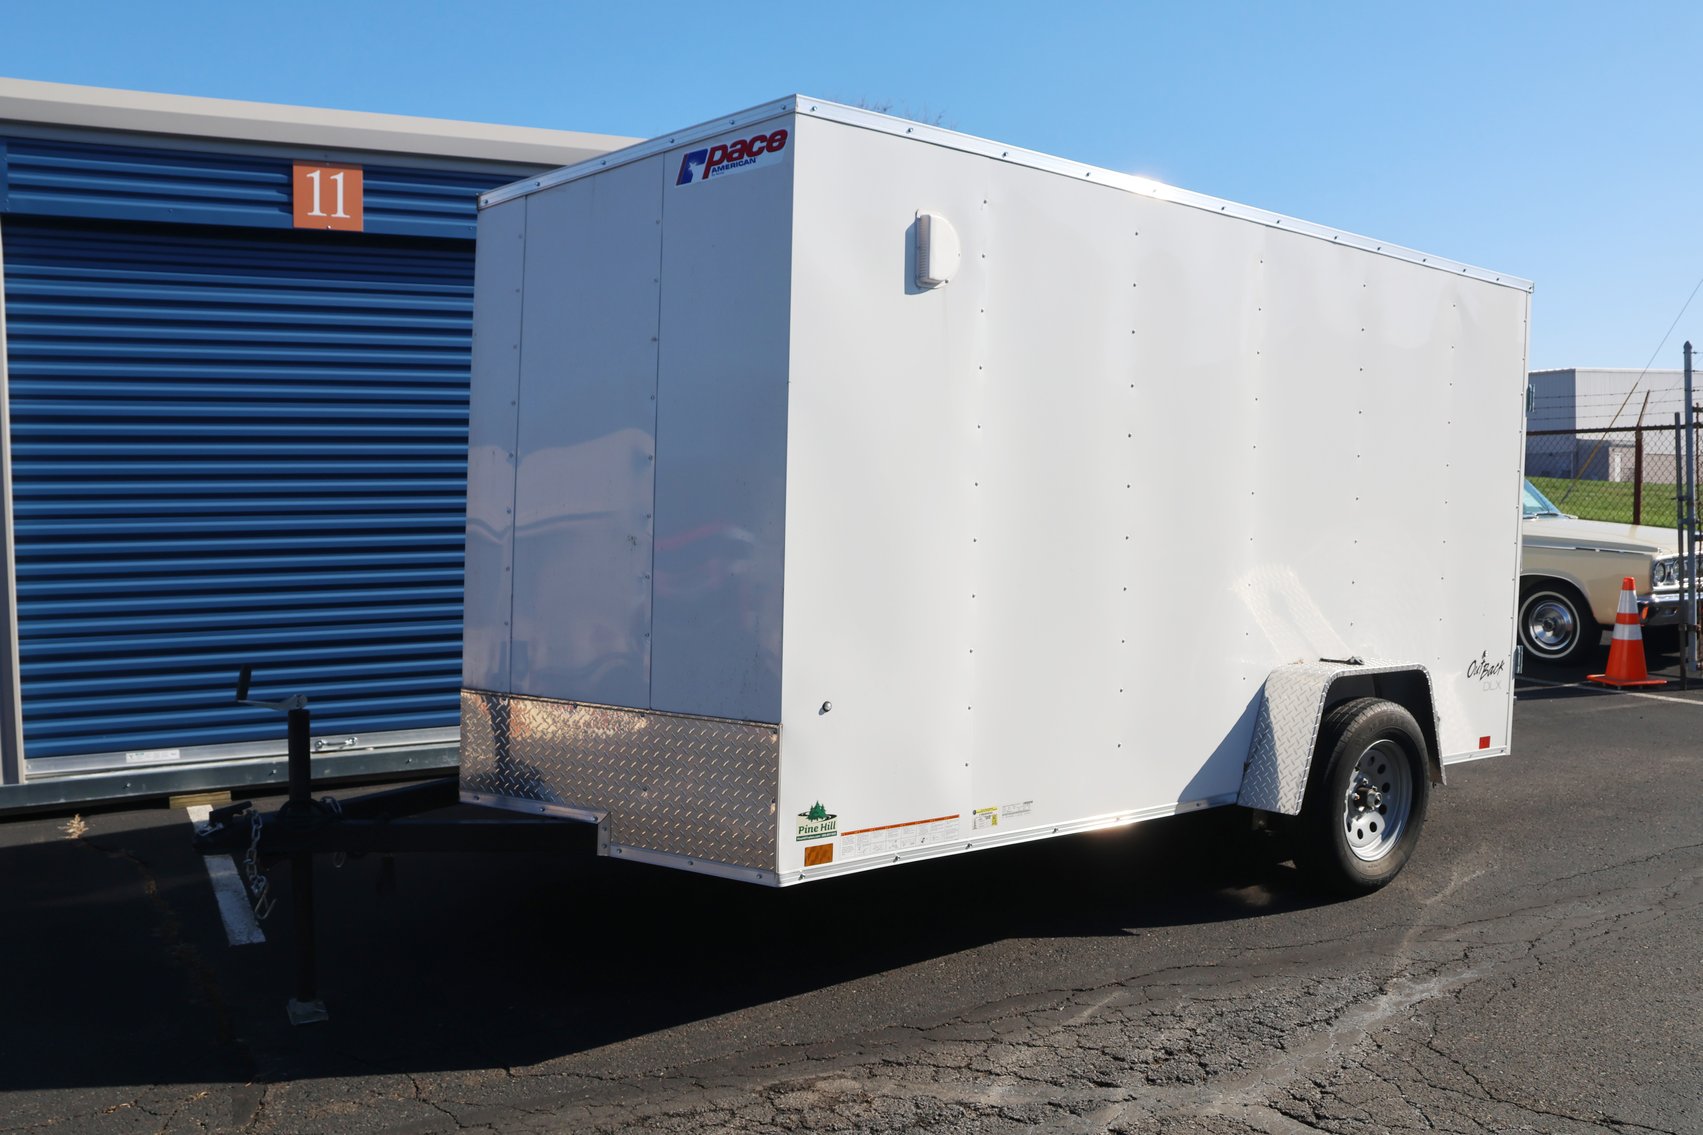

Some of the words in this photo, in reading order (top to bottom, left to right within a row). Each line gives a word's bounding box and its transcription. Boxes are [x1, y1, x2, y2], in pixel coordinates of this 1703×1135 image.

[711, 158, 757, 174] AMERICAN
[306, 169, 351, 218] 11
[798, 825, 819, 834] Pine
[820, 821, 836, 832] Hill
